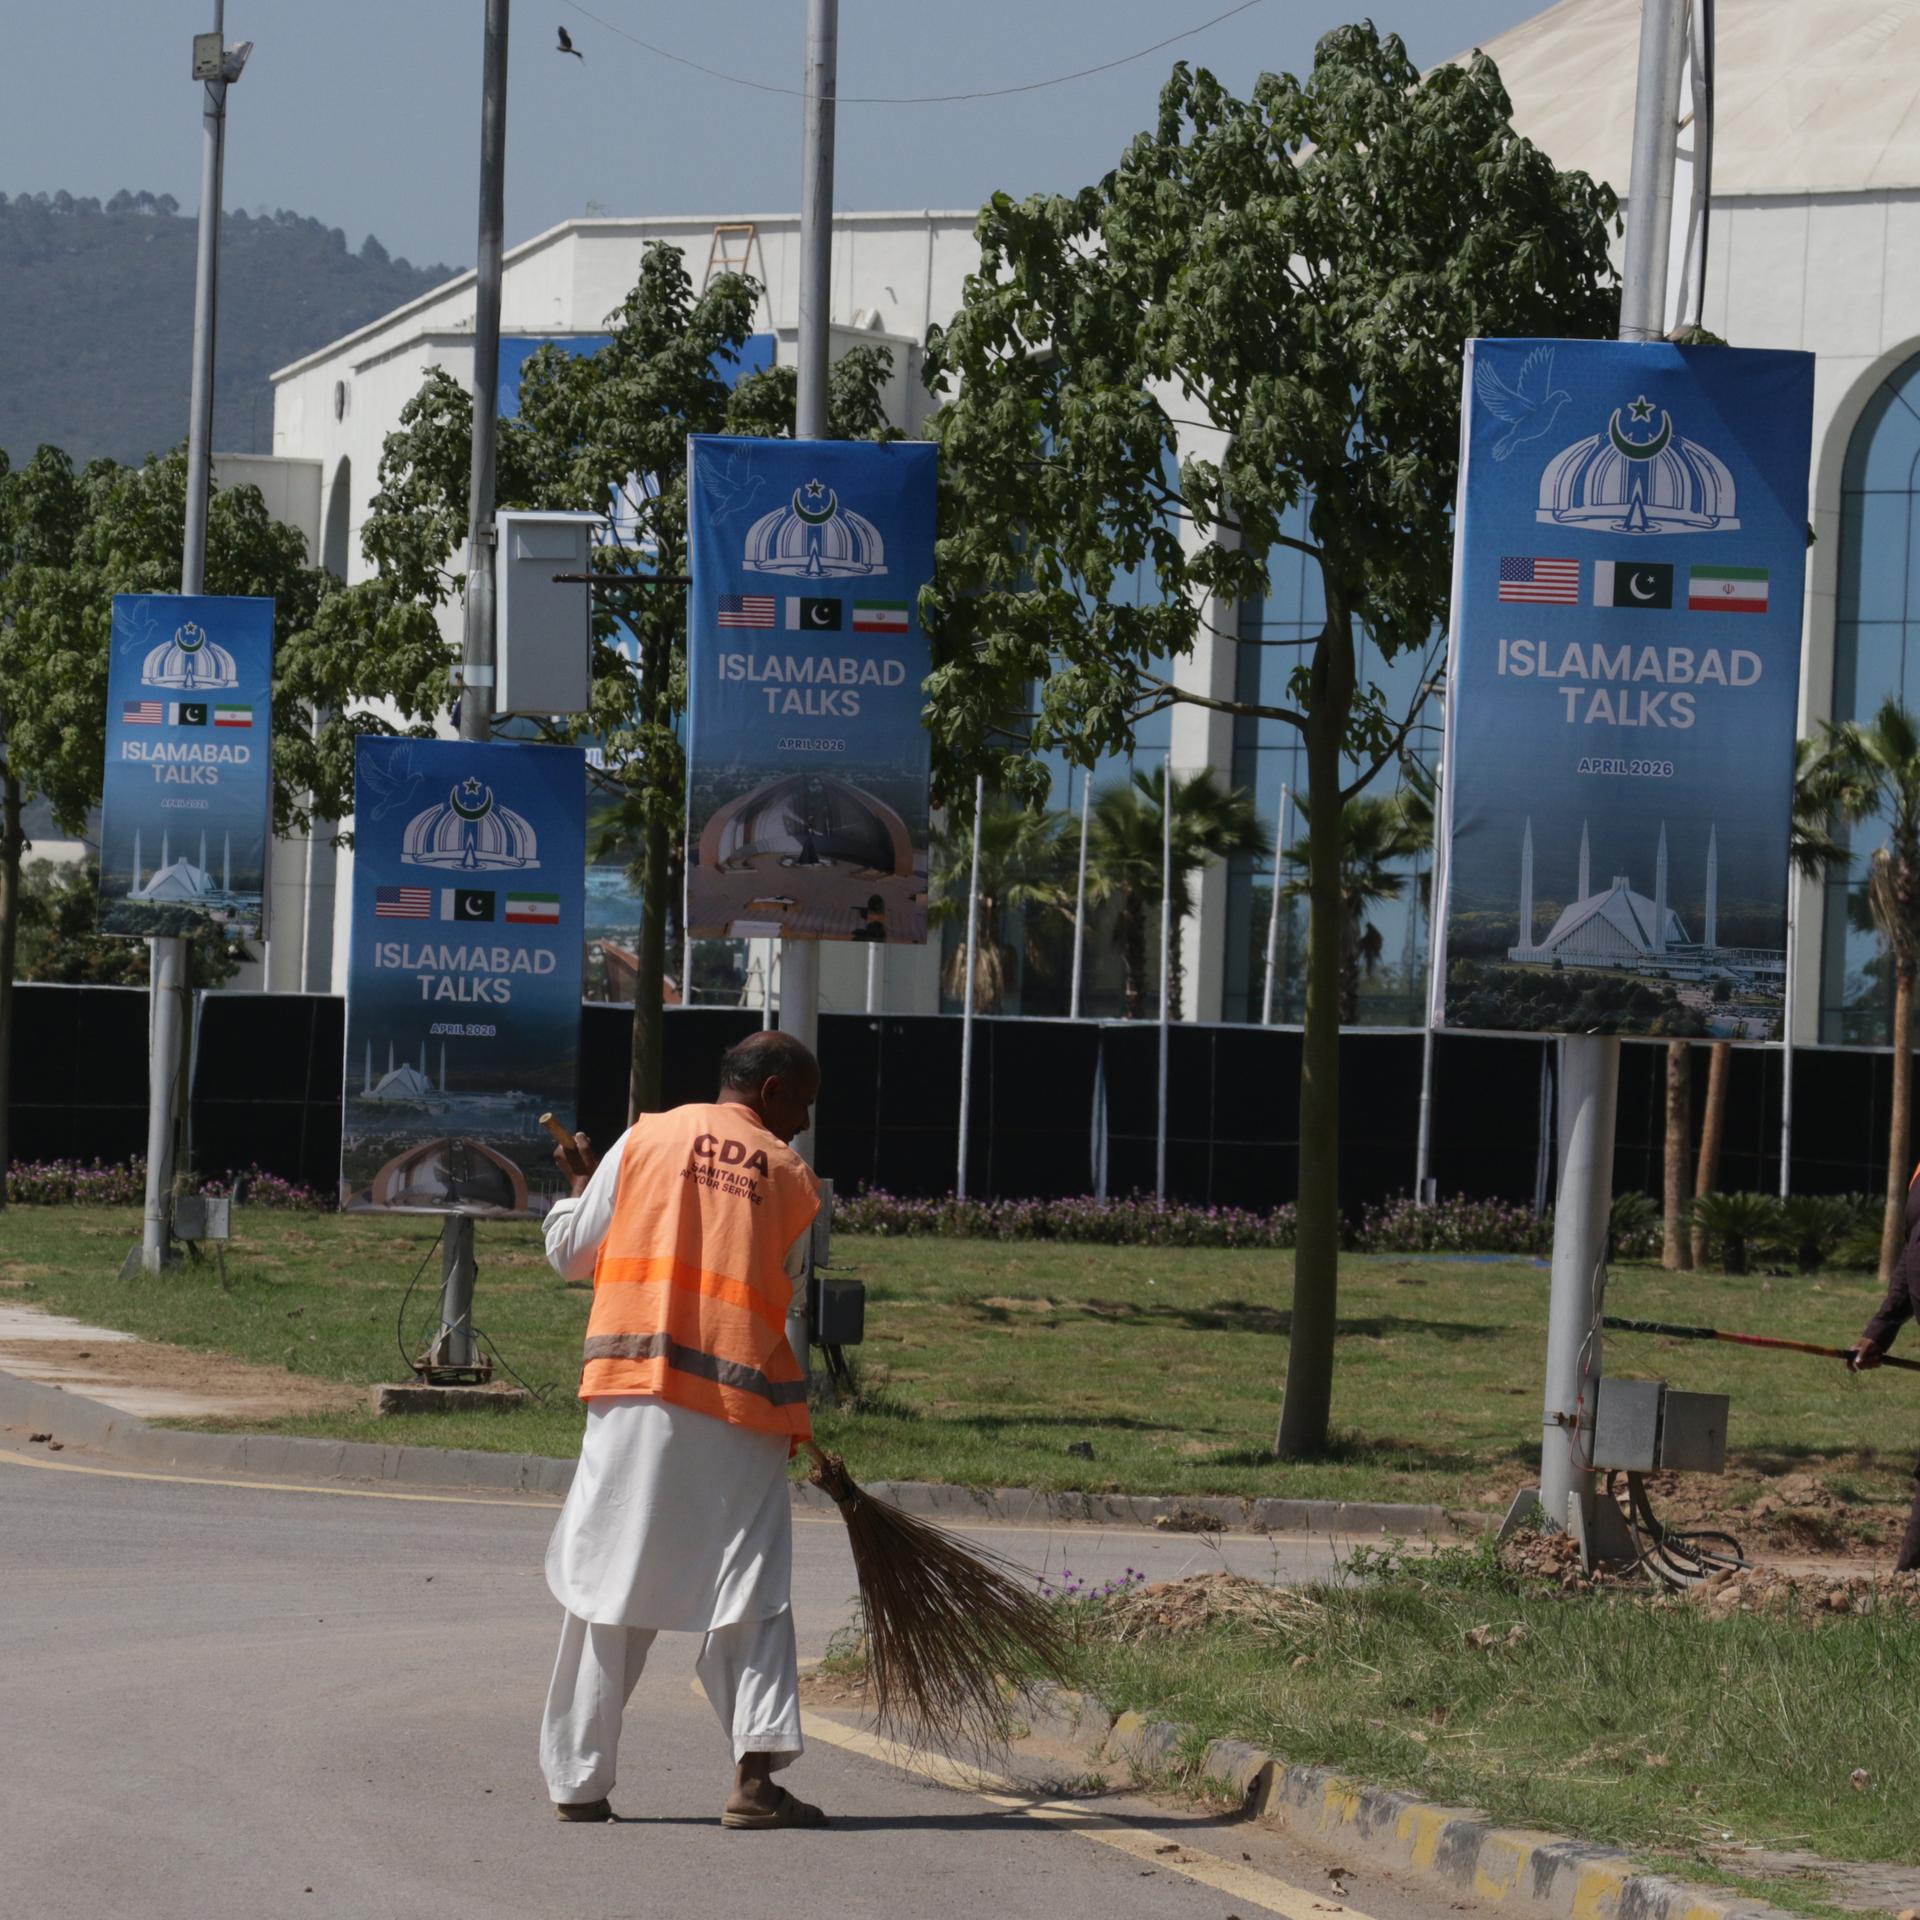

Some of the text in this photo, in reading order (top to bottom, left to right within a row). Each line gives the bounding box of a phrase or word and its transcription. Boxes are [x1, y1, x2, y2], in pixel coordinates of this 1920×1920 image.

[718, 653, 906, 686] ISLAMABAD
[1497, 639, 1763, 687] ISLAMABAD
[762, 687, 861, 717] TALKS
[1559, 686, 1696, 729] TALKS
[122, 741, 250, 764] ISLAMABAD
[777, 737, 845, 751] APRIL 2026
[151, 764, 219, 785] TALKS
[1577, 757, 1674, 777] APRIL 2026
[374, 942, 556, 974] ISLAMABAD
[416, 975, 511, 1003] TALKS
[430, 1023, 496, 1036] APRIL 2026
[694, 1133, 769, 1179] CDA
[691, 1161, 758, 1191] SANITAION
[693, 1175, 720, 1190] YOUR
[721, 1184, 763, 1206] SERVICE
